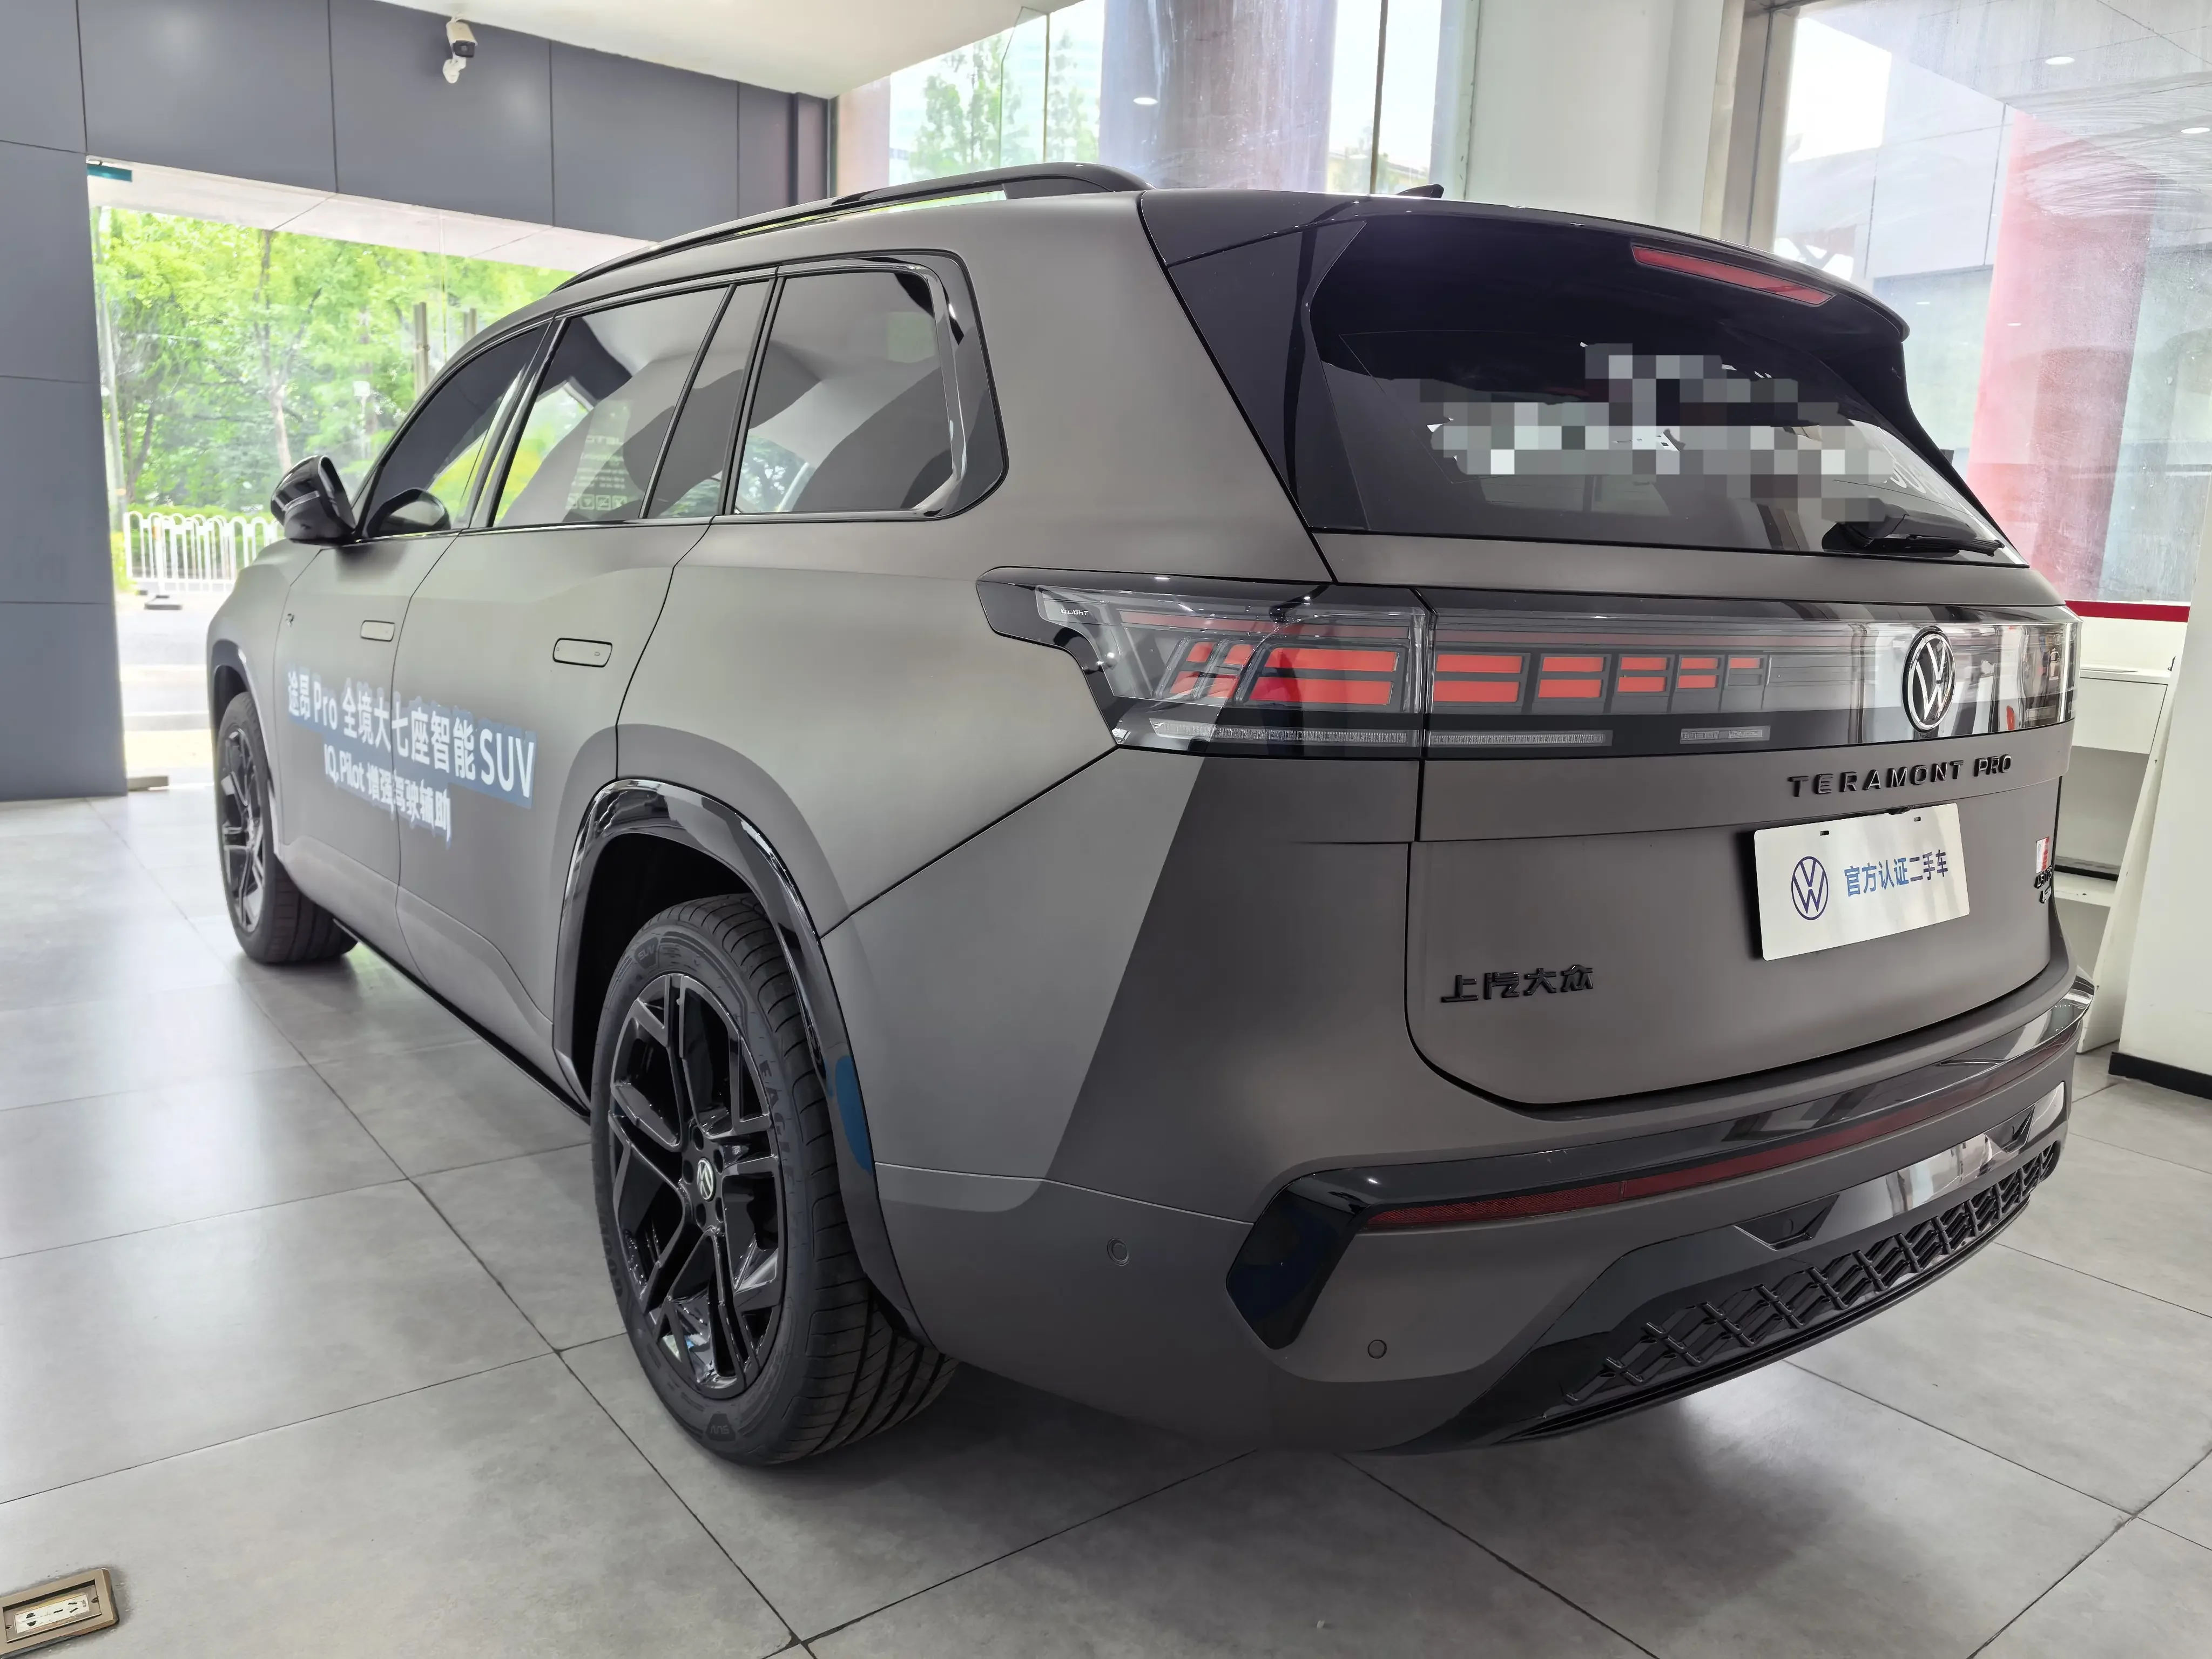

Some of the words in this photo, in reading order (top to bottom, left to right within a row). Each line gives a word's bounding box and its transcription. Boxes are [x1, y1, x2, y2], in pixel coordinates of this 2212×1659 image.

[313, 680, 338, 730] Pro
[480, 729, 535, 798] SUV
[1788, 759, 1964, 797] TERAMONT
[1974, 753, 2012, 777] PRO
[1844, 849, 1948, 898] 官方认证二手车
[637, 943, 655, 961] SUV
[1440, 964, 1593, 1003] 上汽大众
